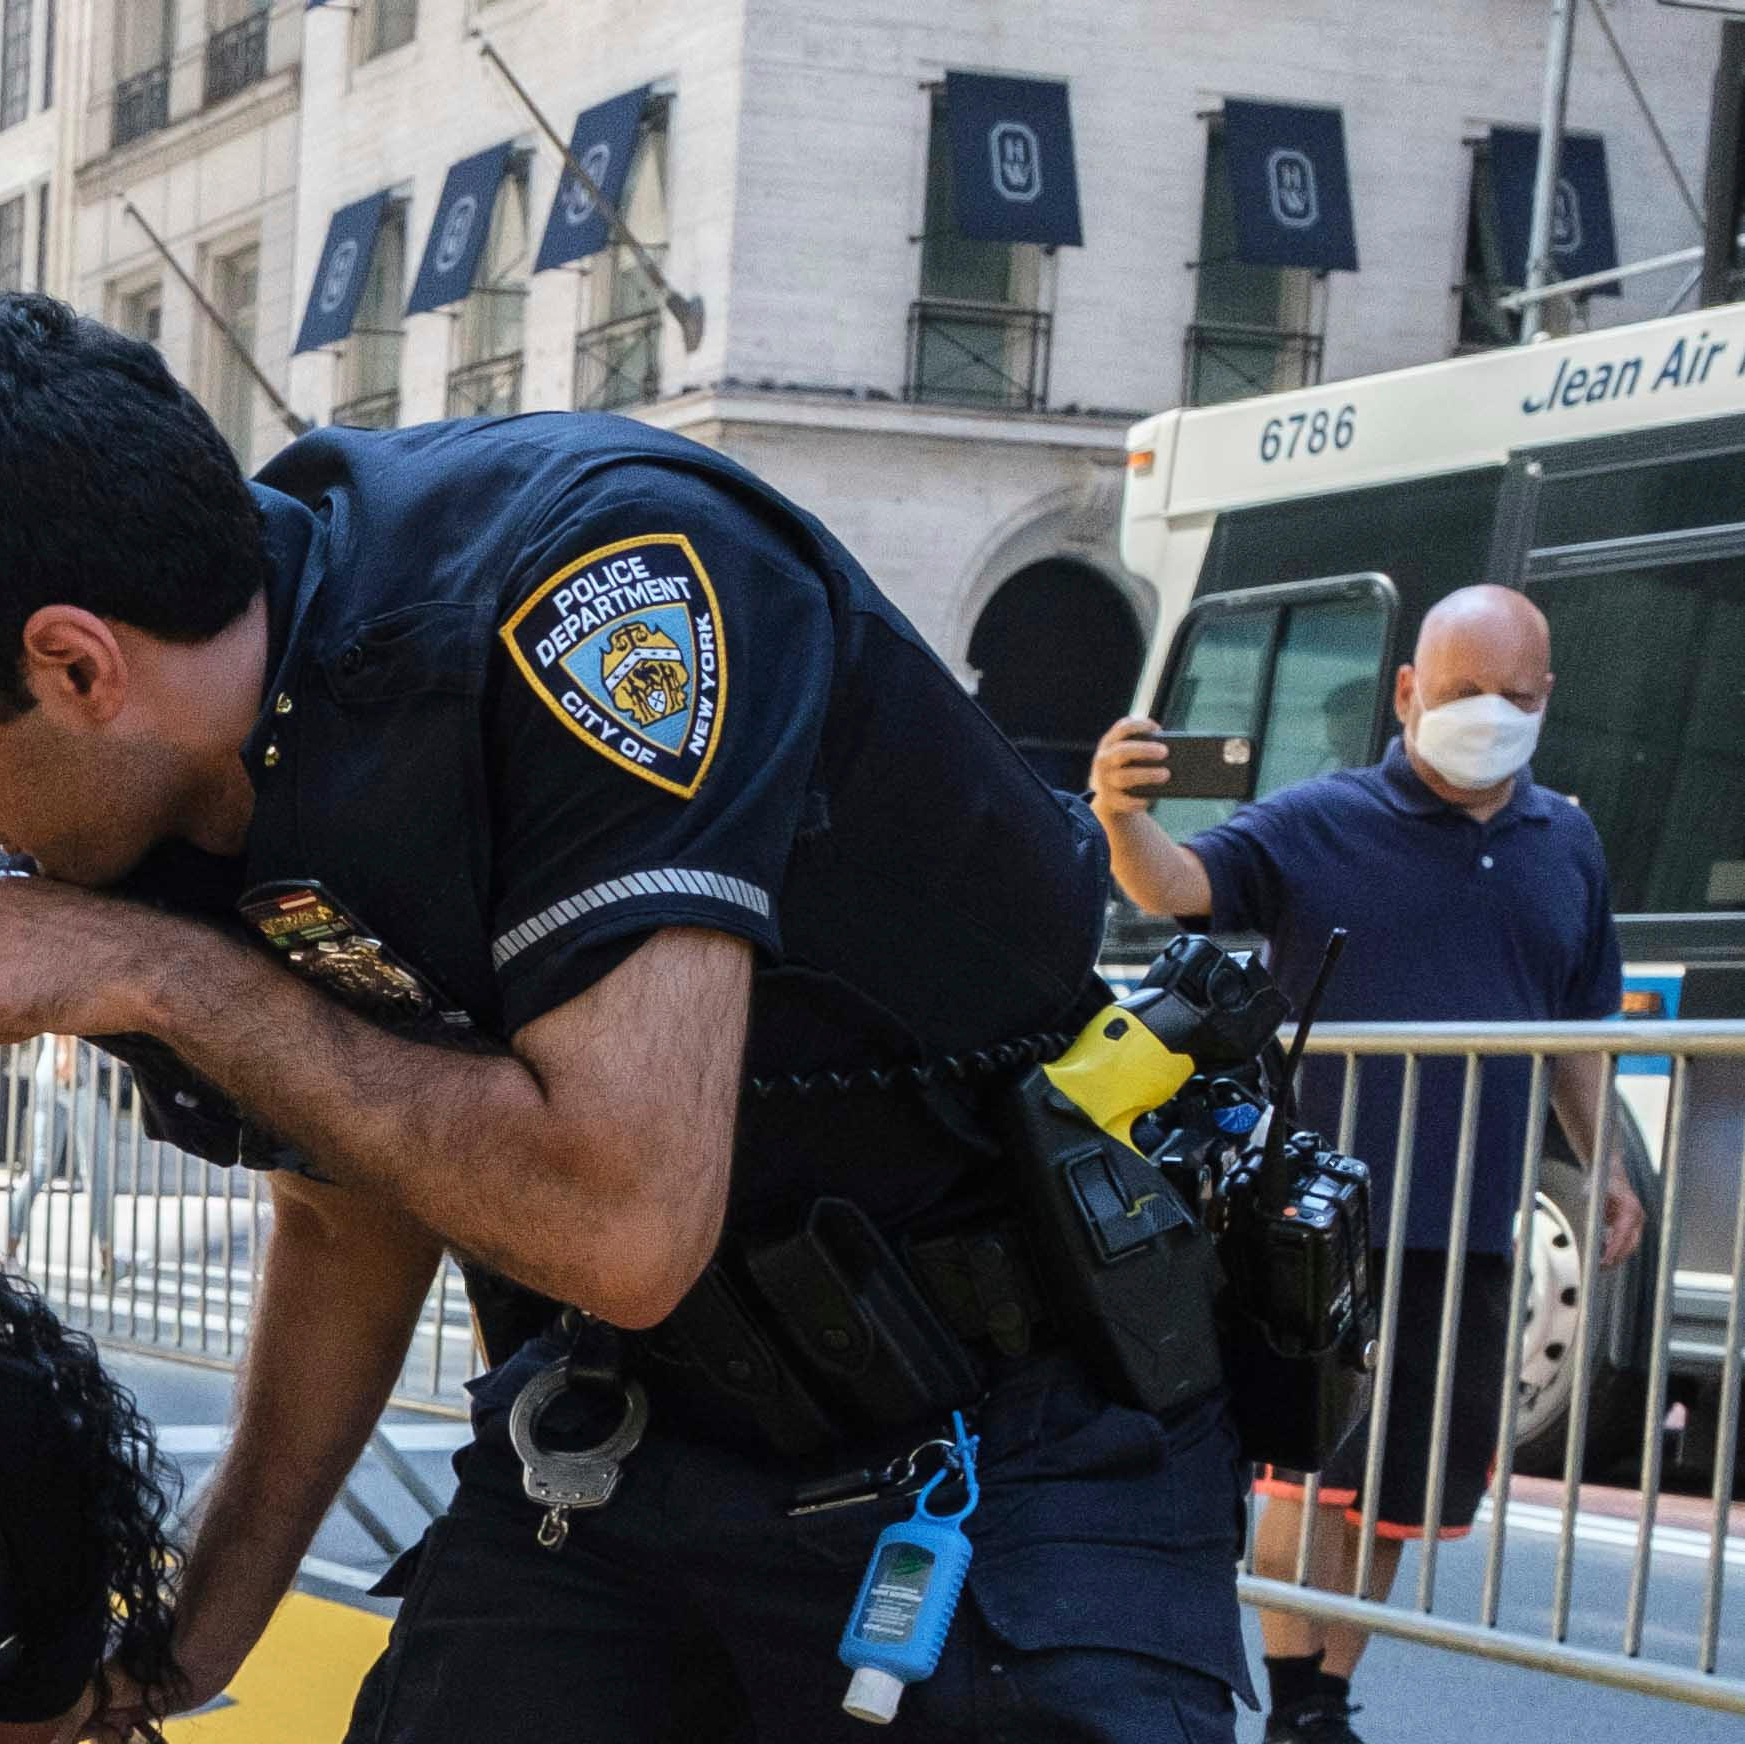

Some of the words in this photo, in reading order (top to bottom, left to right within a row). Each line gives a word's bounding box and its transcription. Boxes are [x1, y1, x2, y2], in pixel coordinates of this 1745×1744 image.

[1521, 356, 1643, 416] lean
[1650, 329, 1729, 392] Air
[1259, 404, 1358, 463] 6786
[535, 576, 693, 668] DEPARTMENT
[552, 556, 651, 617] POLICE
[695, 612, 716, 689] YORK
[560, 690, 621, 742] CITY
[619, 736, 658, 765] OF
[688, 695, 714, 757] NEW
